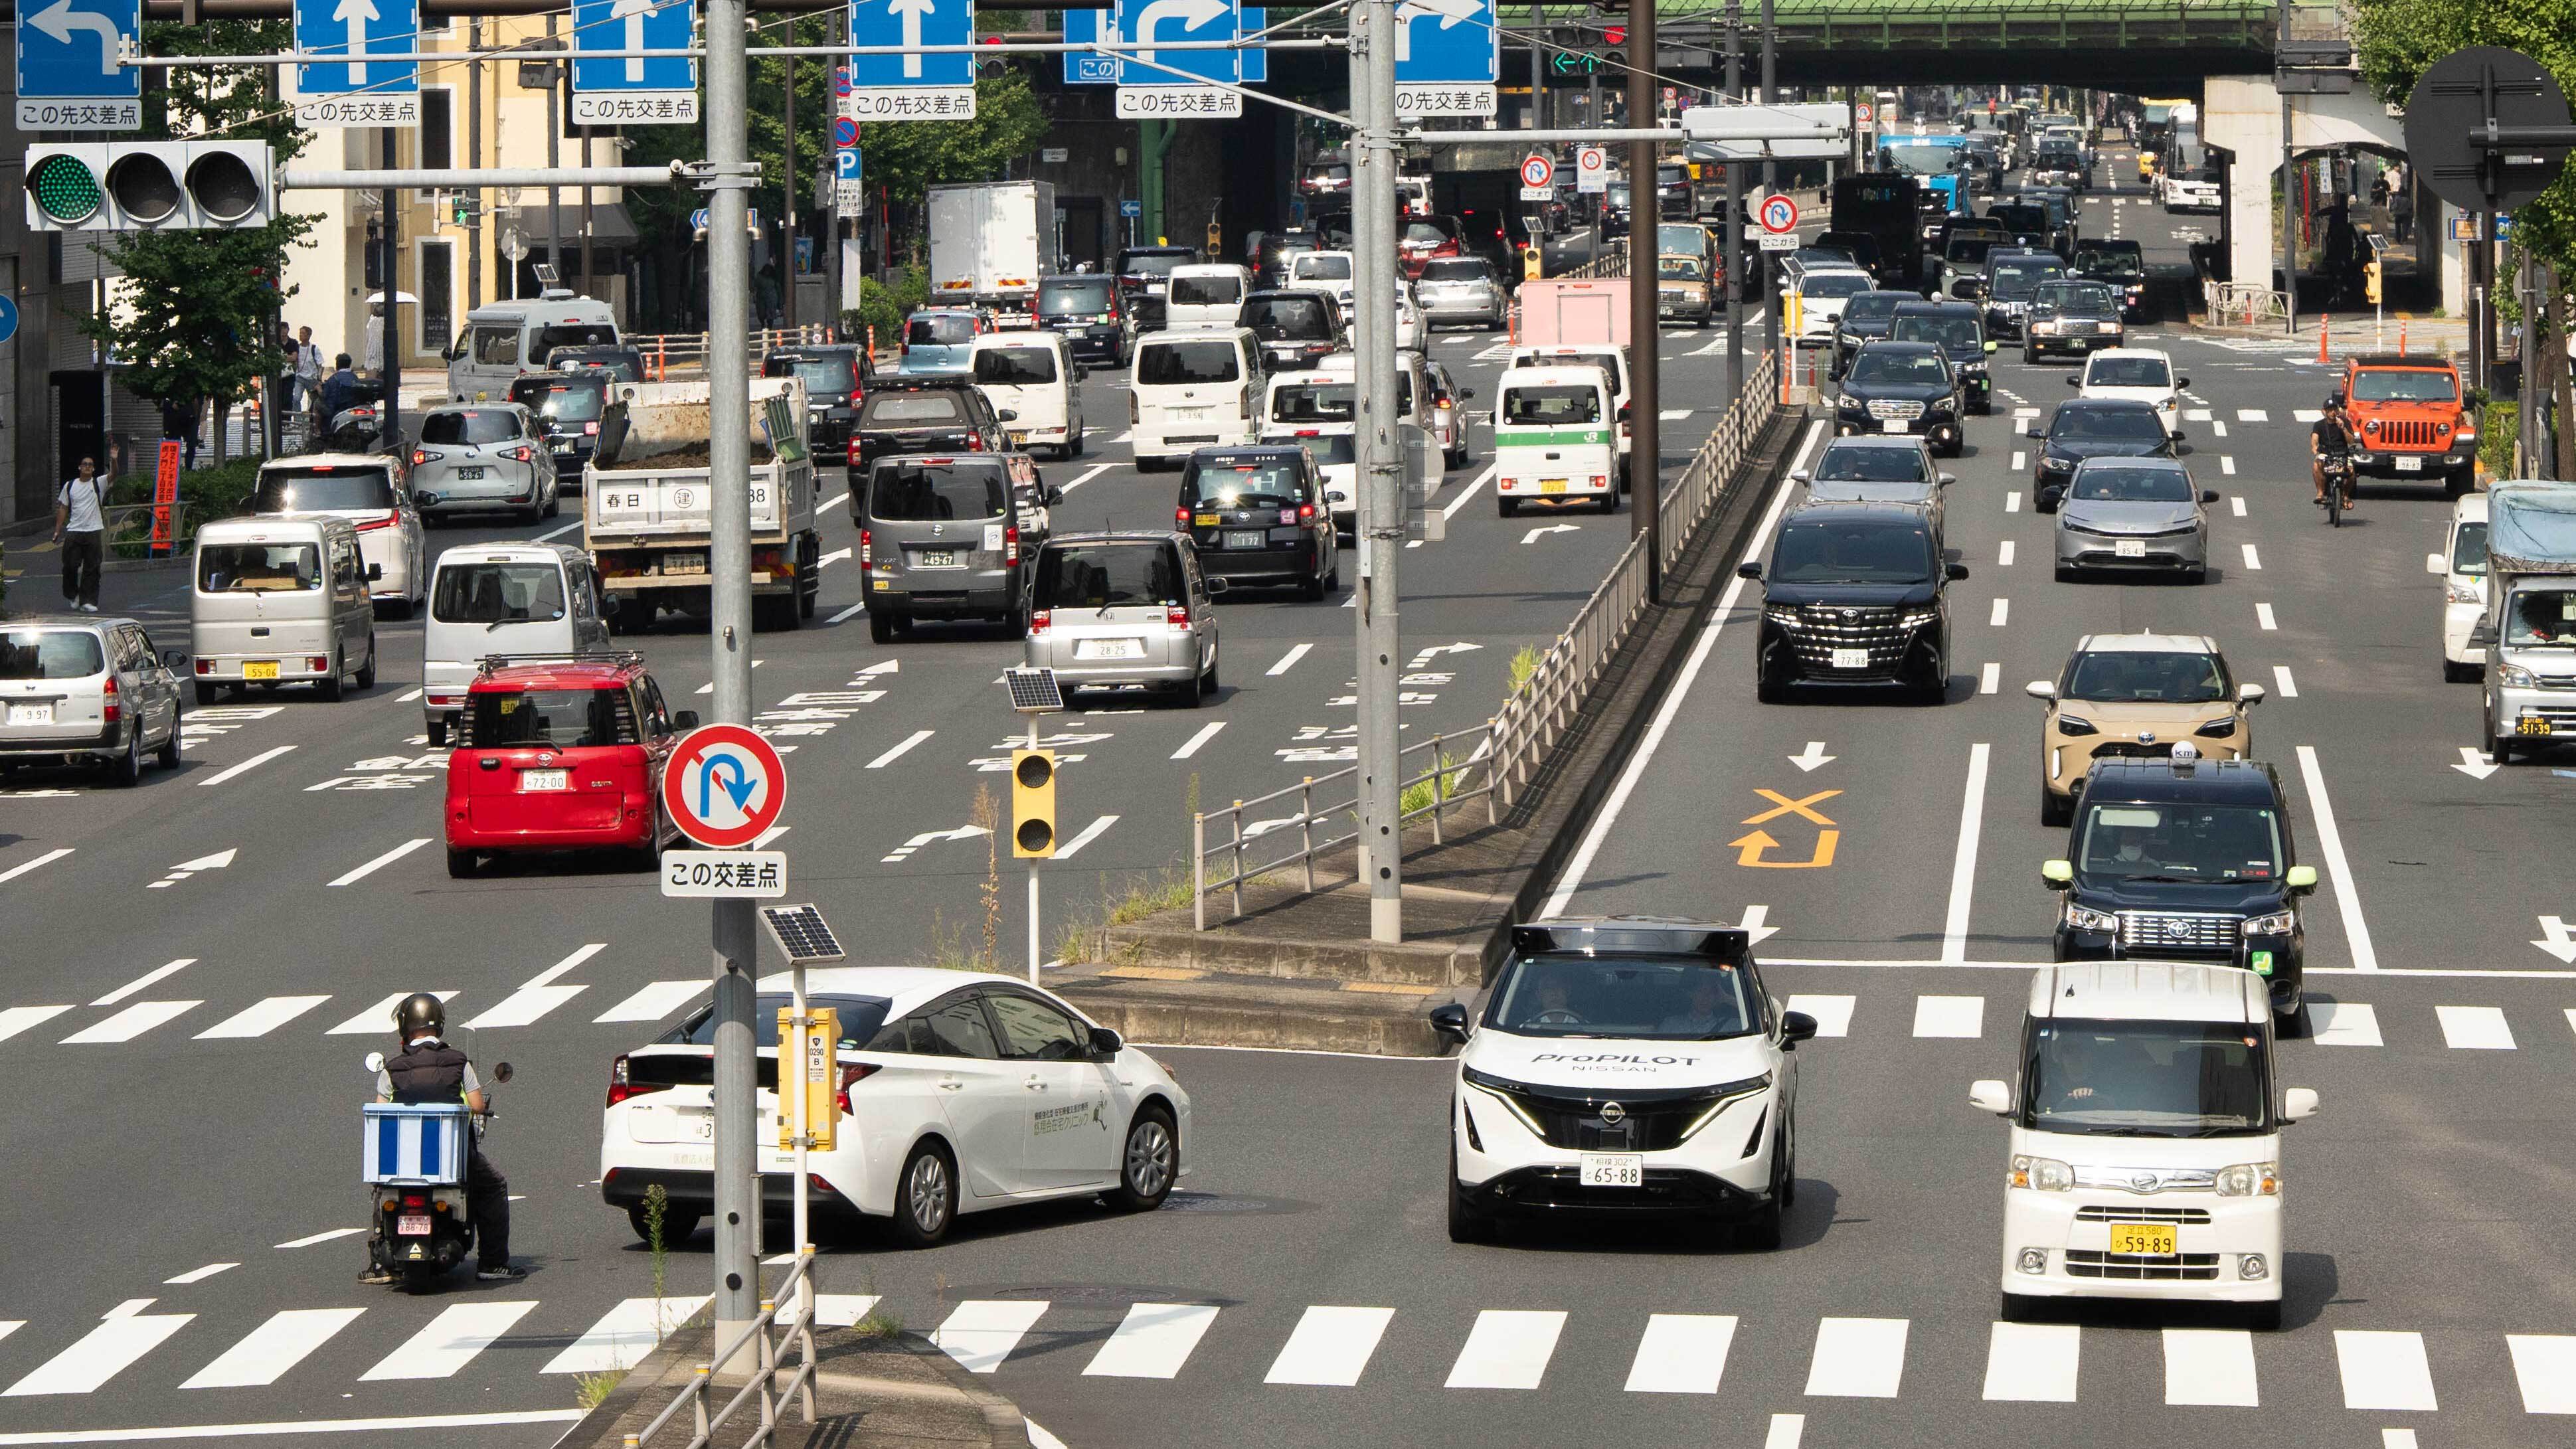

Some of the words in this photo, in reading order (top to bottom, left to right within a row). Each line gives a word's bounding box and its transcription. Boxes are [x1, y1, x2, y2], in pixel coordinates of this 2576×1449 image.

[857, 94, 970, 114] この先交差点
[1123, 94, 1236, 112] この先交差点
[1396, 91, 1491, 110] の先交差点
[24, 105, 137, 124] この先交差点
[302, 104, 416, 122] この先交差点
[580, 100, 693, 118] この先交差点
[839, 151, 857, 177] P
[1762, 238, 1796, 246] ここから
[608, 493, 640, 507] 春日
[677, 492, 690, 505] 建
[252, 668, 276, 677] 55-06
[2523, 724, 2550, 734] 51-39
[533, 778, 564, 789] 72-00
[671, 861, 778, 888] この交差点
[809, 1048, 823, 1057] 0290
[1531, 1054, 1701, 1066] proPILOT
[1594, 1168, 1638, 1183] 65-88
[2125, 1236, 2172, 1253] 59-89
